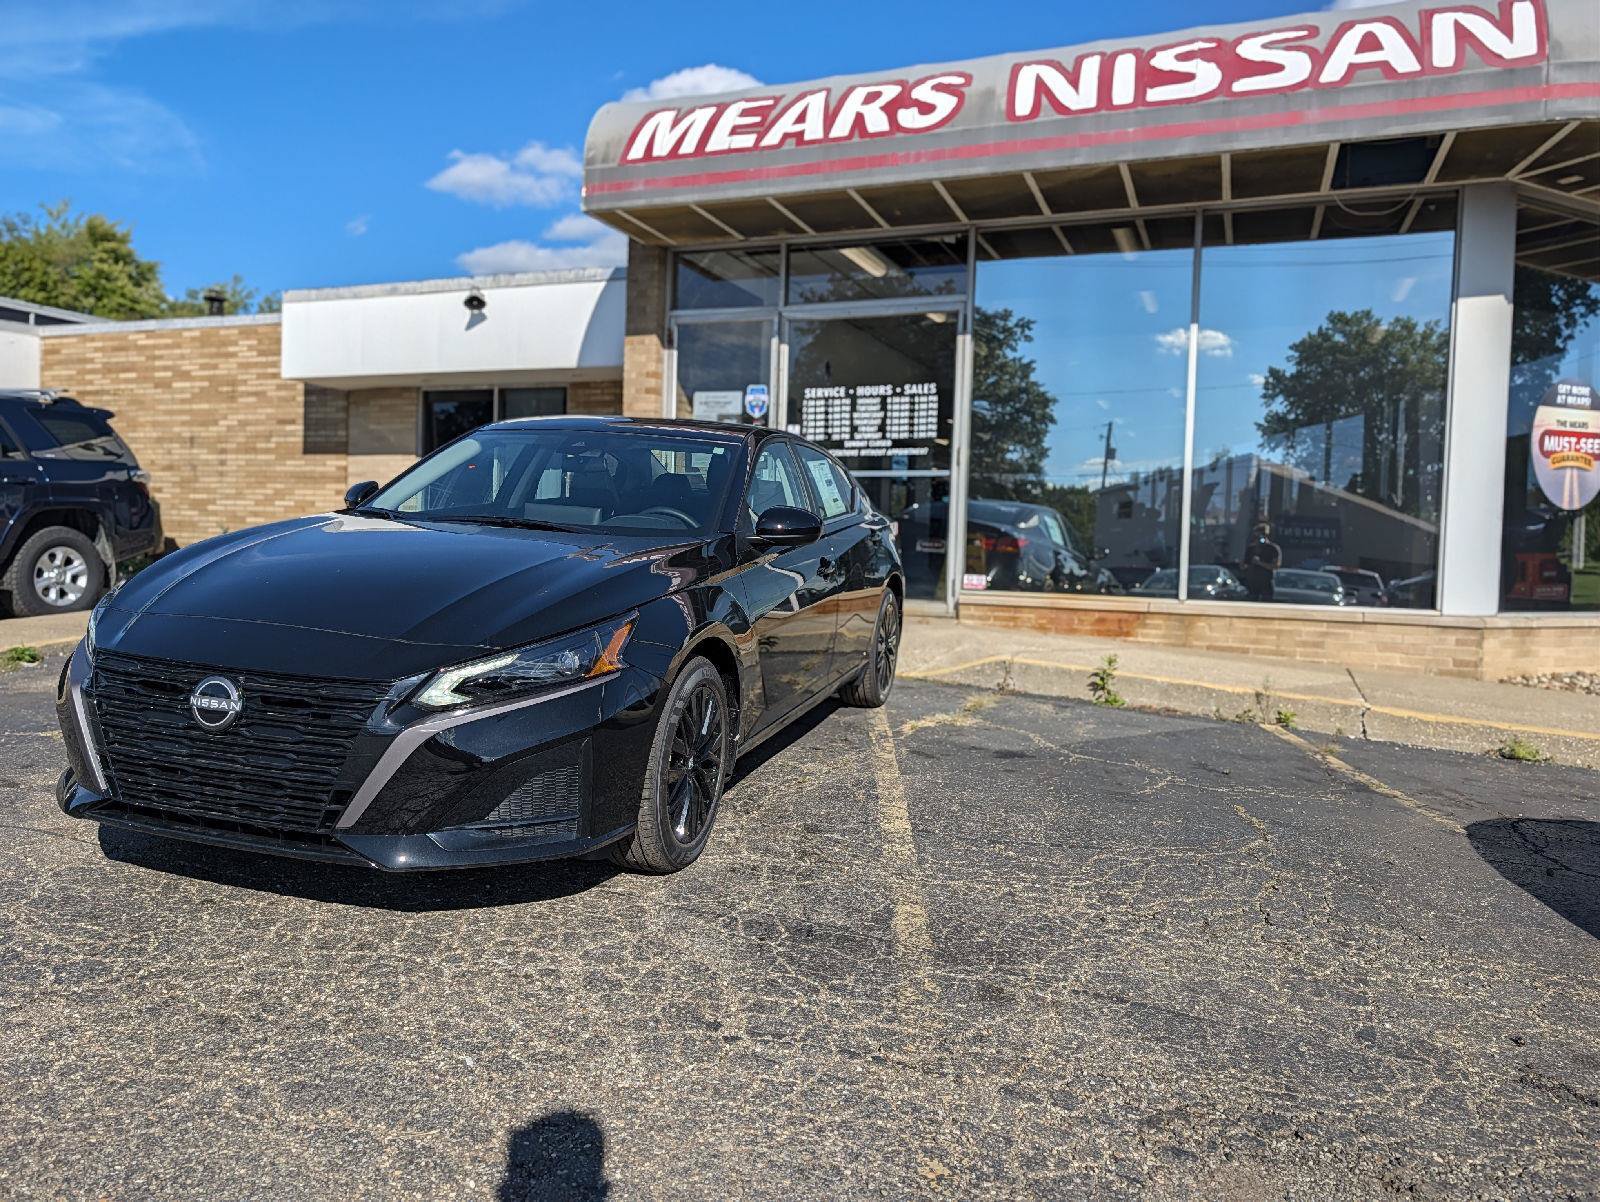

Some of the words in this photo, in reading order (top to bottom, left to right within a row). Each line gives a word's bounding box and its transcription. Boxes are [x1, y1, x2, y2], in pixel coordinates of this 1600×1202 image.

[623, 73, 970, 162] MEARS
[1012, 0, 1541, 118] NISSAN
[804, 386, 846, 399] SERVICE
[856, 384, 893, 397] HOURS
[903, 382, 937, 395] SALES
[1556, 419, 1568, 428] THE
[1544, 435, 1600, 454] MUST-SEE
[190, 695, 240, 711] NISSAN
